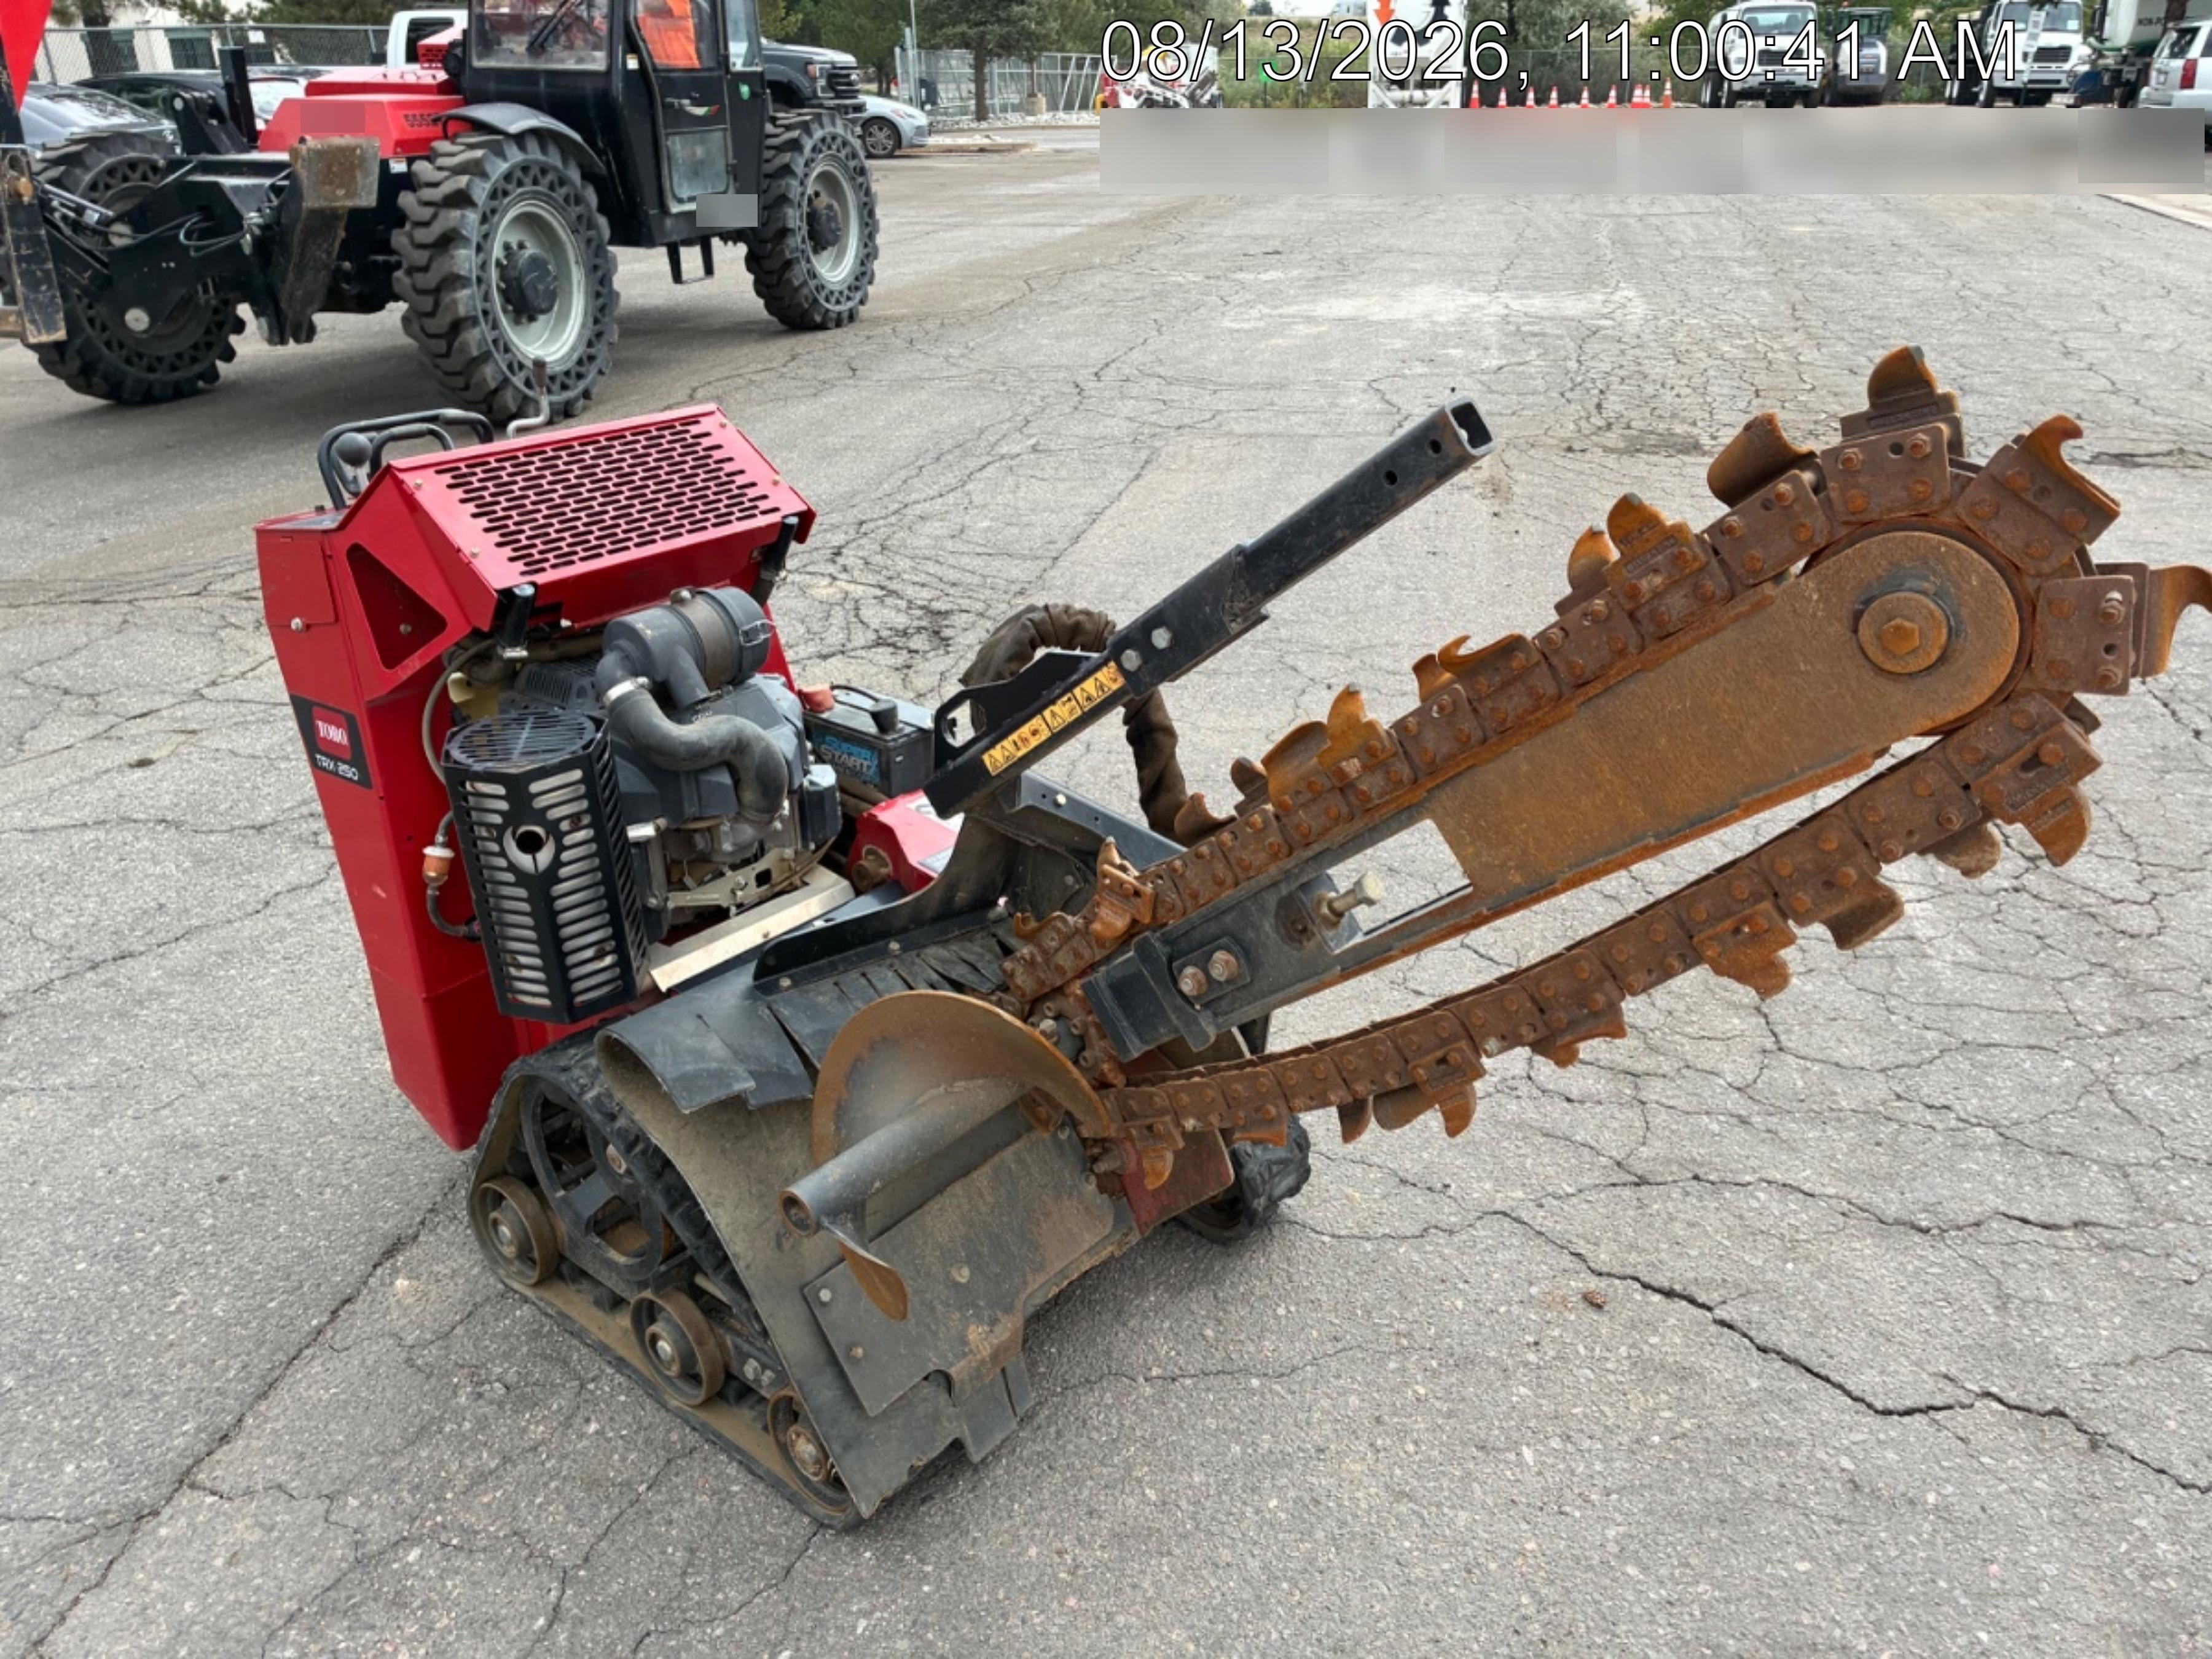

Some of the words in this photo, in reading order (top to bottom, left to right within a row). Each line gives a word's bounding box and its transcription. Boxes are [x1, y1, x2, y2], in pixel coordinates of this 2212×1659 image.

[315, 720, 349, 746] TORO
[315, 753, 336, 773] TRX
[820, 744, 874, 773] START
